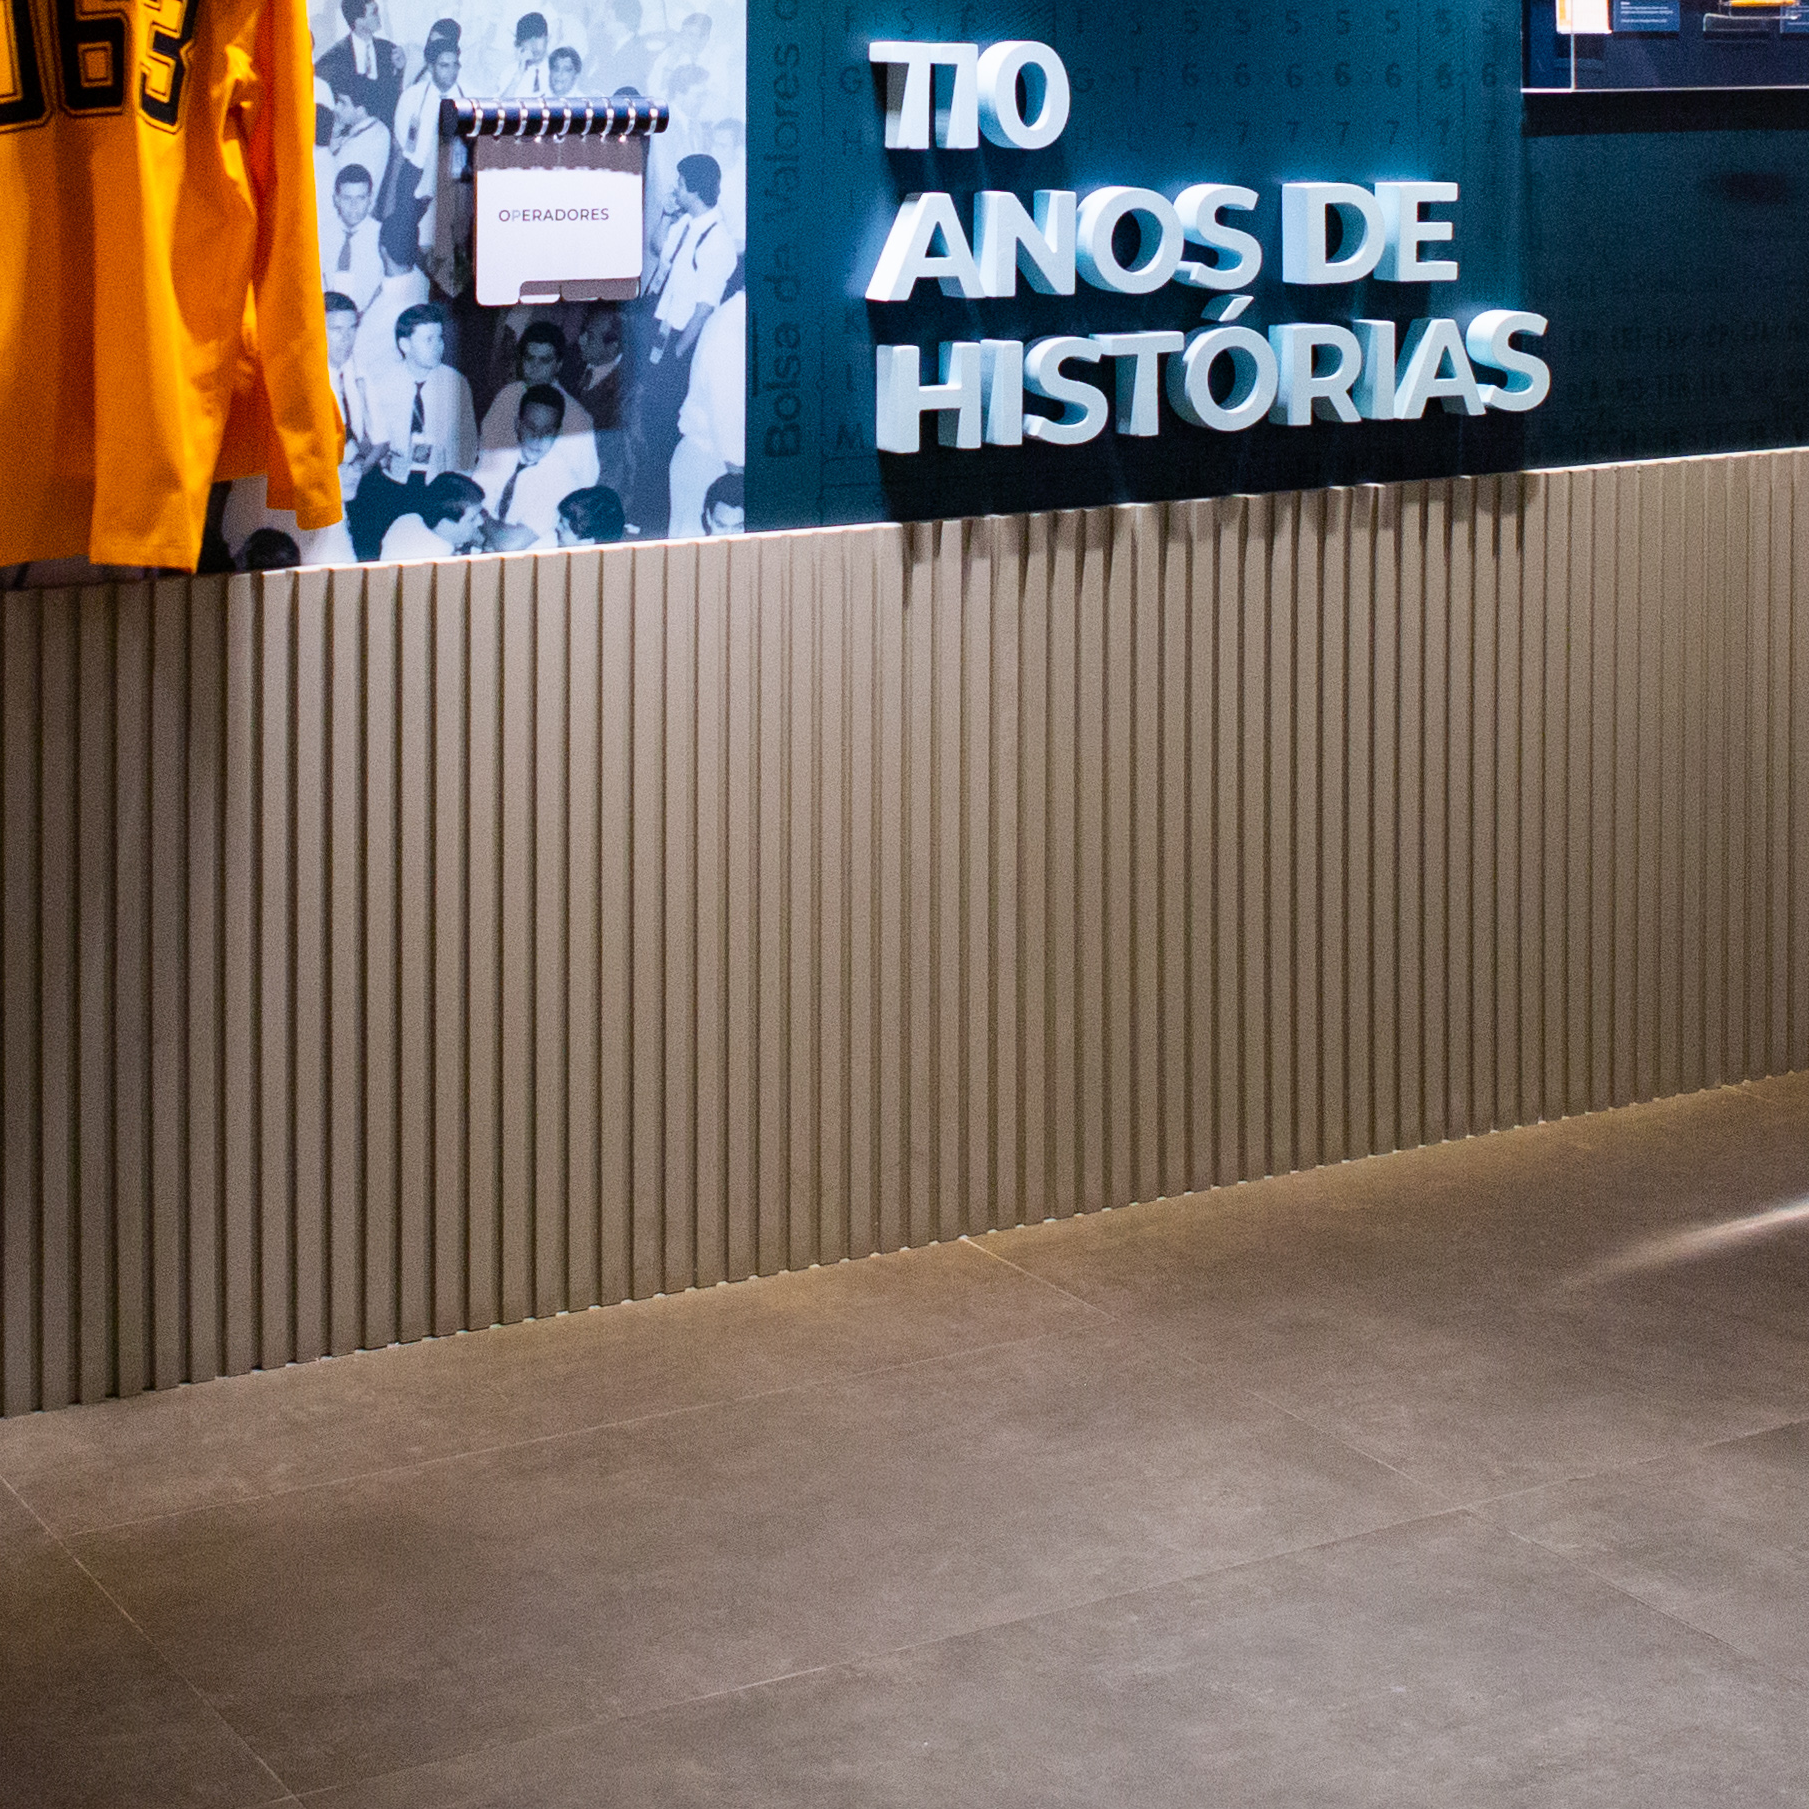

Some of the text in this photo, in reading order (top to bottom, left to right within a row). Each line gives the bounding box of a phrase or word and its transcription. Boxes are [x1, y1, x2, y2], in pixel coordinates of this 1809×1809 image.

[498, 207, 610, 223] OPERADORES
[864, 180, 1459, 302] ANOS DE
[876, 294, 1552, 454] HISTÓRIAS
